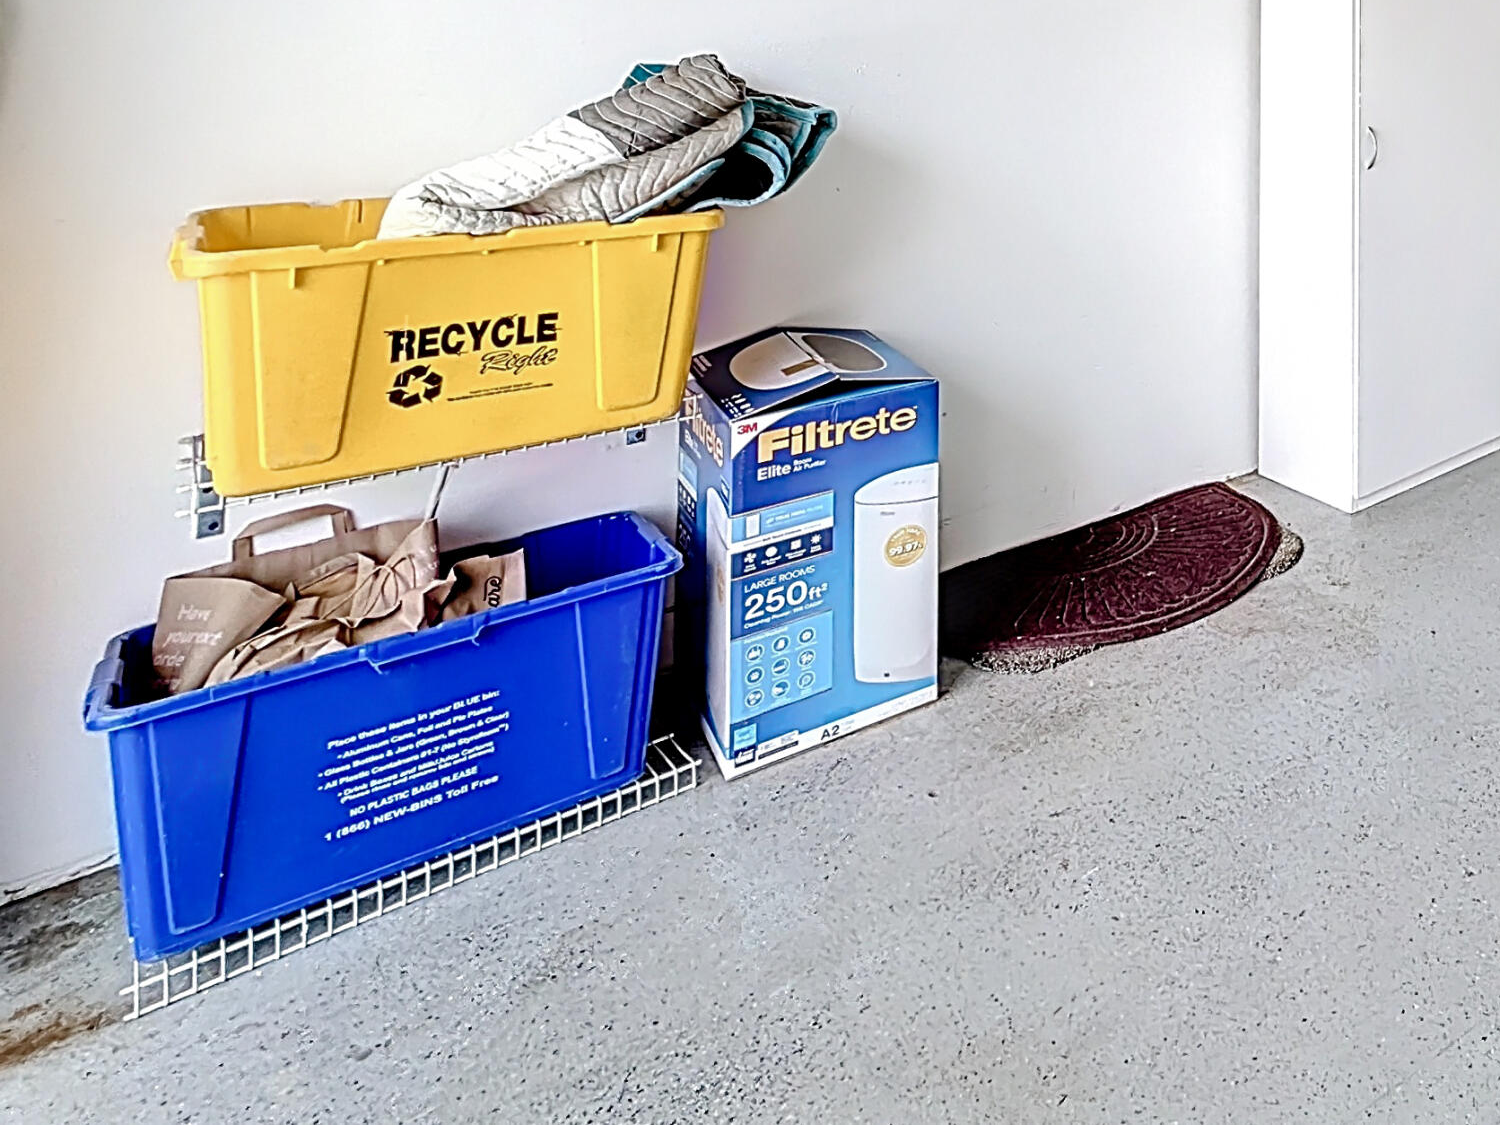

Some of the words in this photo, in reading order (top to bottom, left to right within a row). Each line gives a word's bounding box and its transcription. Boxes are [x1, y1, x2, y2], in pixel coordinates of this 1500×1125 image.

[390, 312, 559, 363] RECYCLE
[480, 345, 558, 376] Right
[737, 422, 758, 435] 3M
[757, 407, 917, 464] Filtrete
[757, 464, 792, 482] Elite
[744, 576, 777, 593] LARGE
[779, 565, 816, 582] ROOMS
[327, 735, 357, 750] Place
[358, 726, 387, 740] these
[417, 713, 428, 721] in
[429, 705, 452, 719] your
[453, 694, 481, 710] BLUE
[482, 689, 500, 701] bin:
[342, 739, 390, 759] Aluminum
[435, 718, 452, 729] and
[820, 724, 840, 741] A2
[352, 752, 385, 768] Bottles
[386, 748, 394, 757] &
[477, 719, 484, 727] &
[324, 779, 338, 790] All
[339, 770, 370, 785] Plastic
[371, 754, 420, 775] Containers
[350, 804, 366, 818] NO
[367, 789, 410, 811] PLASTIC
[411, 779, 439, 797] BAGS
[440, 765, 478, 786] PLEASE
[324, 831, 333, 842] 1
[336, 819, 371, 839] (866)
[373, 793, 443, 825] NEW-BINS
[445, 784, 469, 799] Toll
[471, 775, 499, 791] Free
